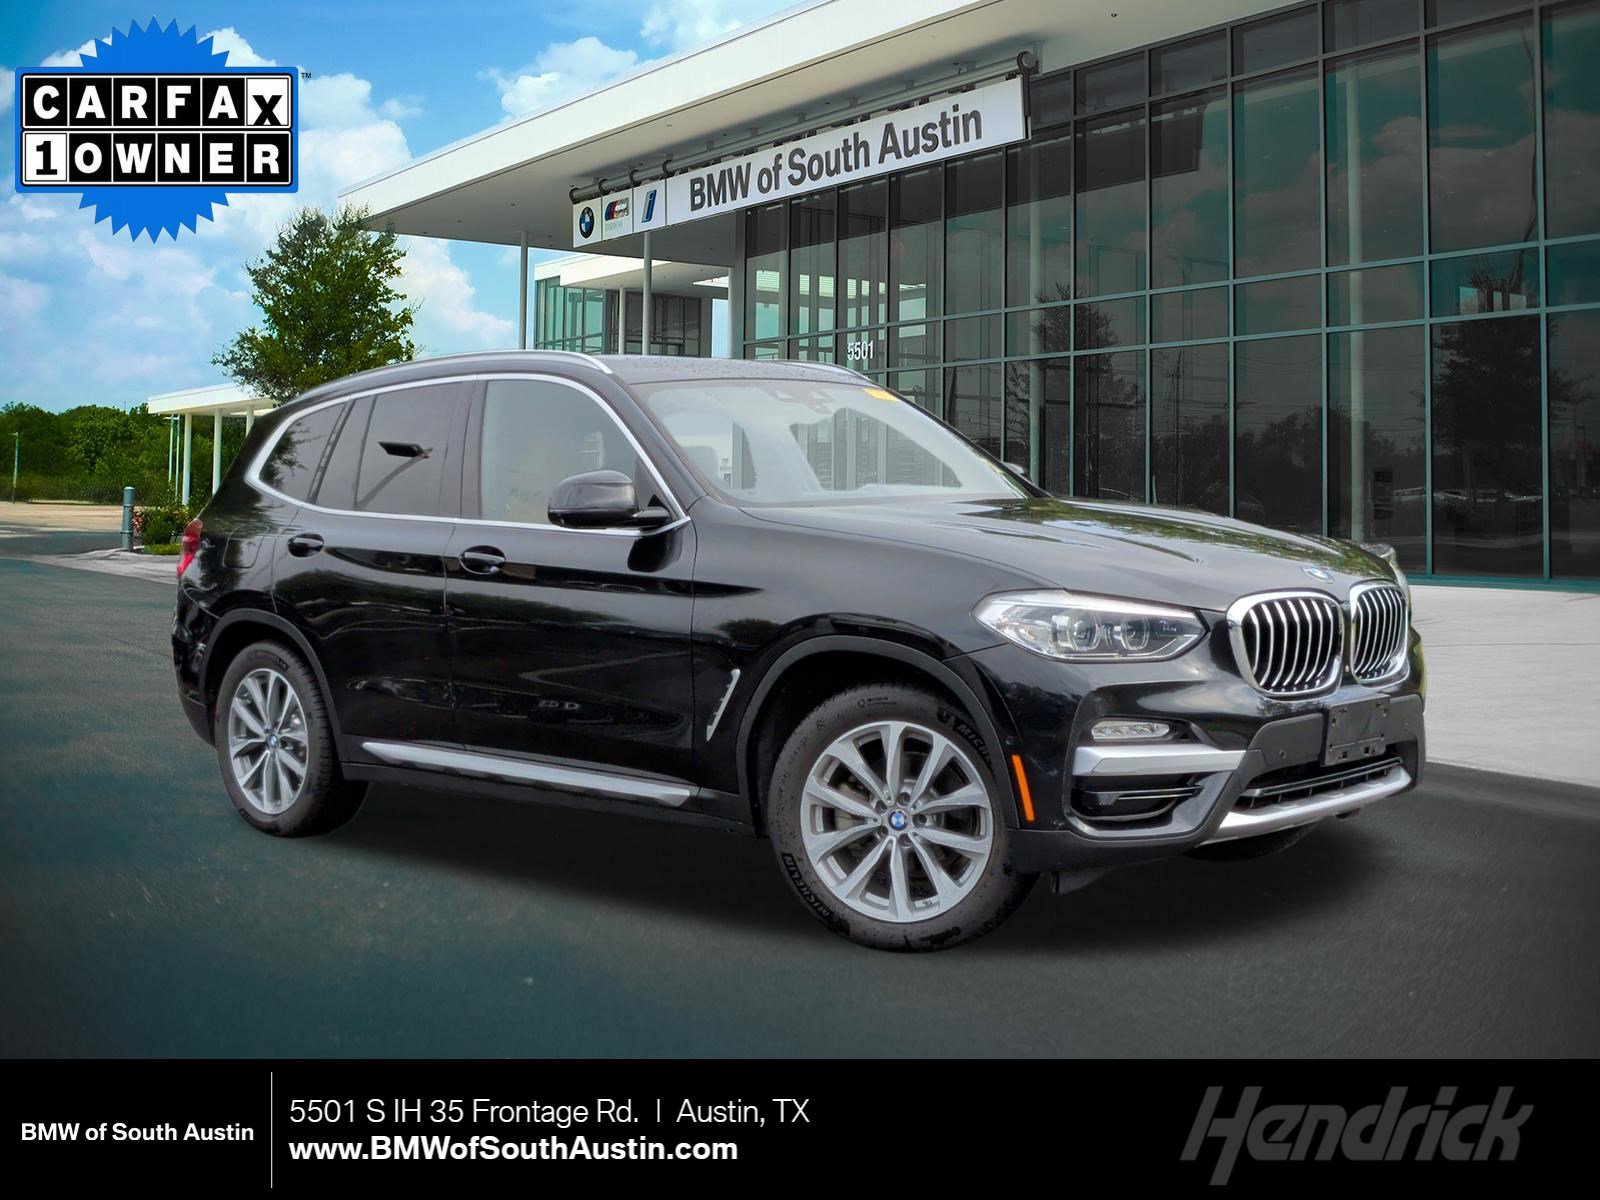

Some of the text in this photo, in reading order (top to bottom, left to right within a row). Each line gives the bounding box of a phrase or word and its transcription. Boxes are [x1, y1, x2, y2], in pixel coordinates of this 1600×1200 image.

[690, 104, 983, 212] BMW of South Austin
[847, 340, 874, 361] 5501
